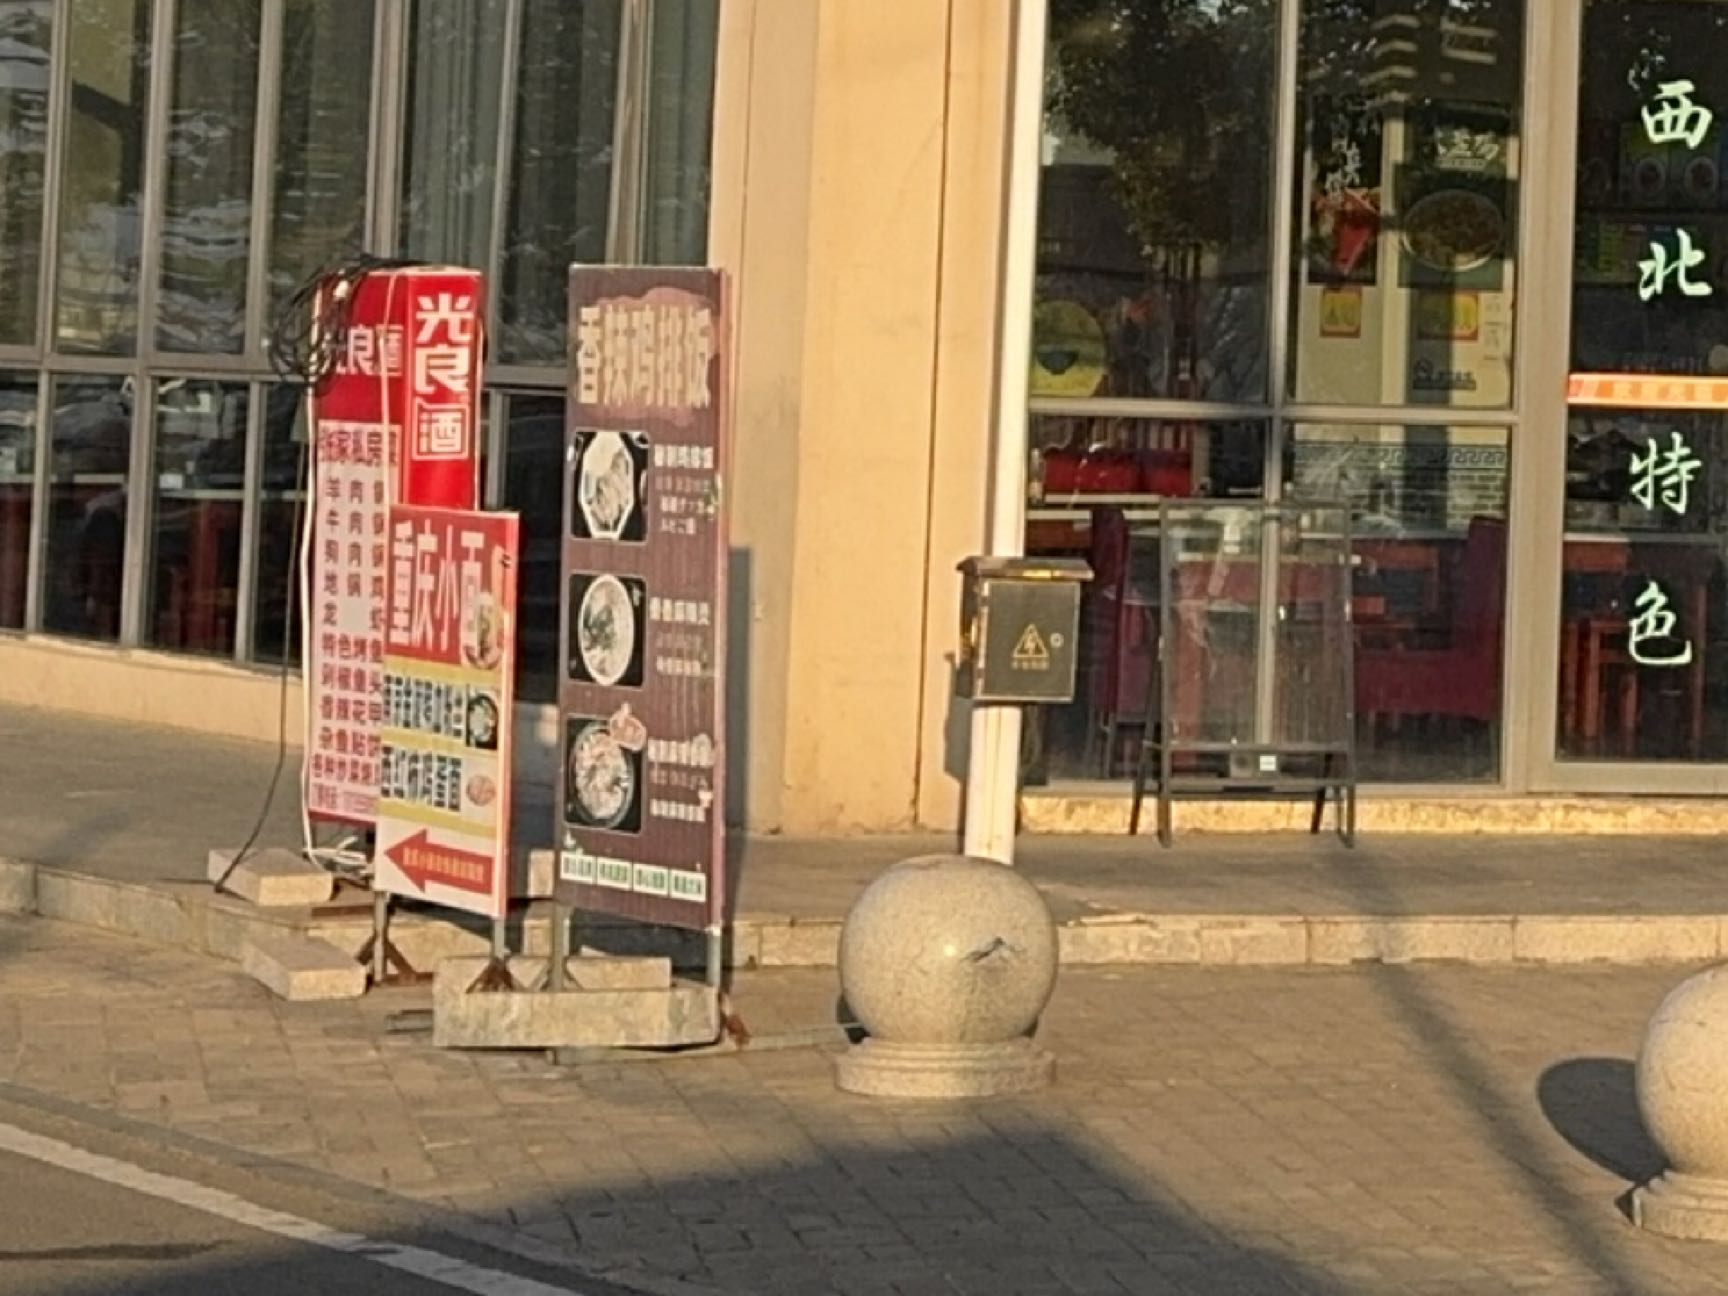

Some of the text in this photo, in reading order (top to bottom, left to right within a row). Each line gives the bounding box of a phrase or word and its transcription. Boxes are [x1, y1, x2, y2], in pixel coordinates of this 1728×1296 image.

[411, 292, 475, 461] 光良酒
[1626, 79, 1714, 667] 西北特色
